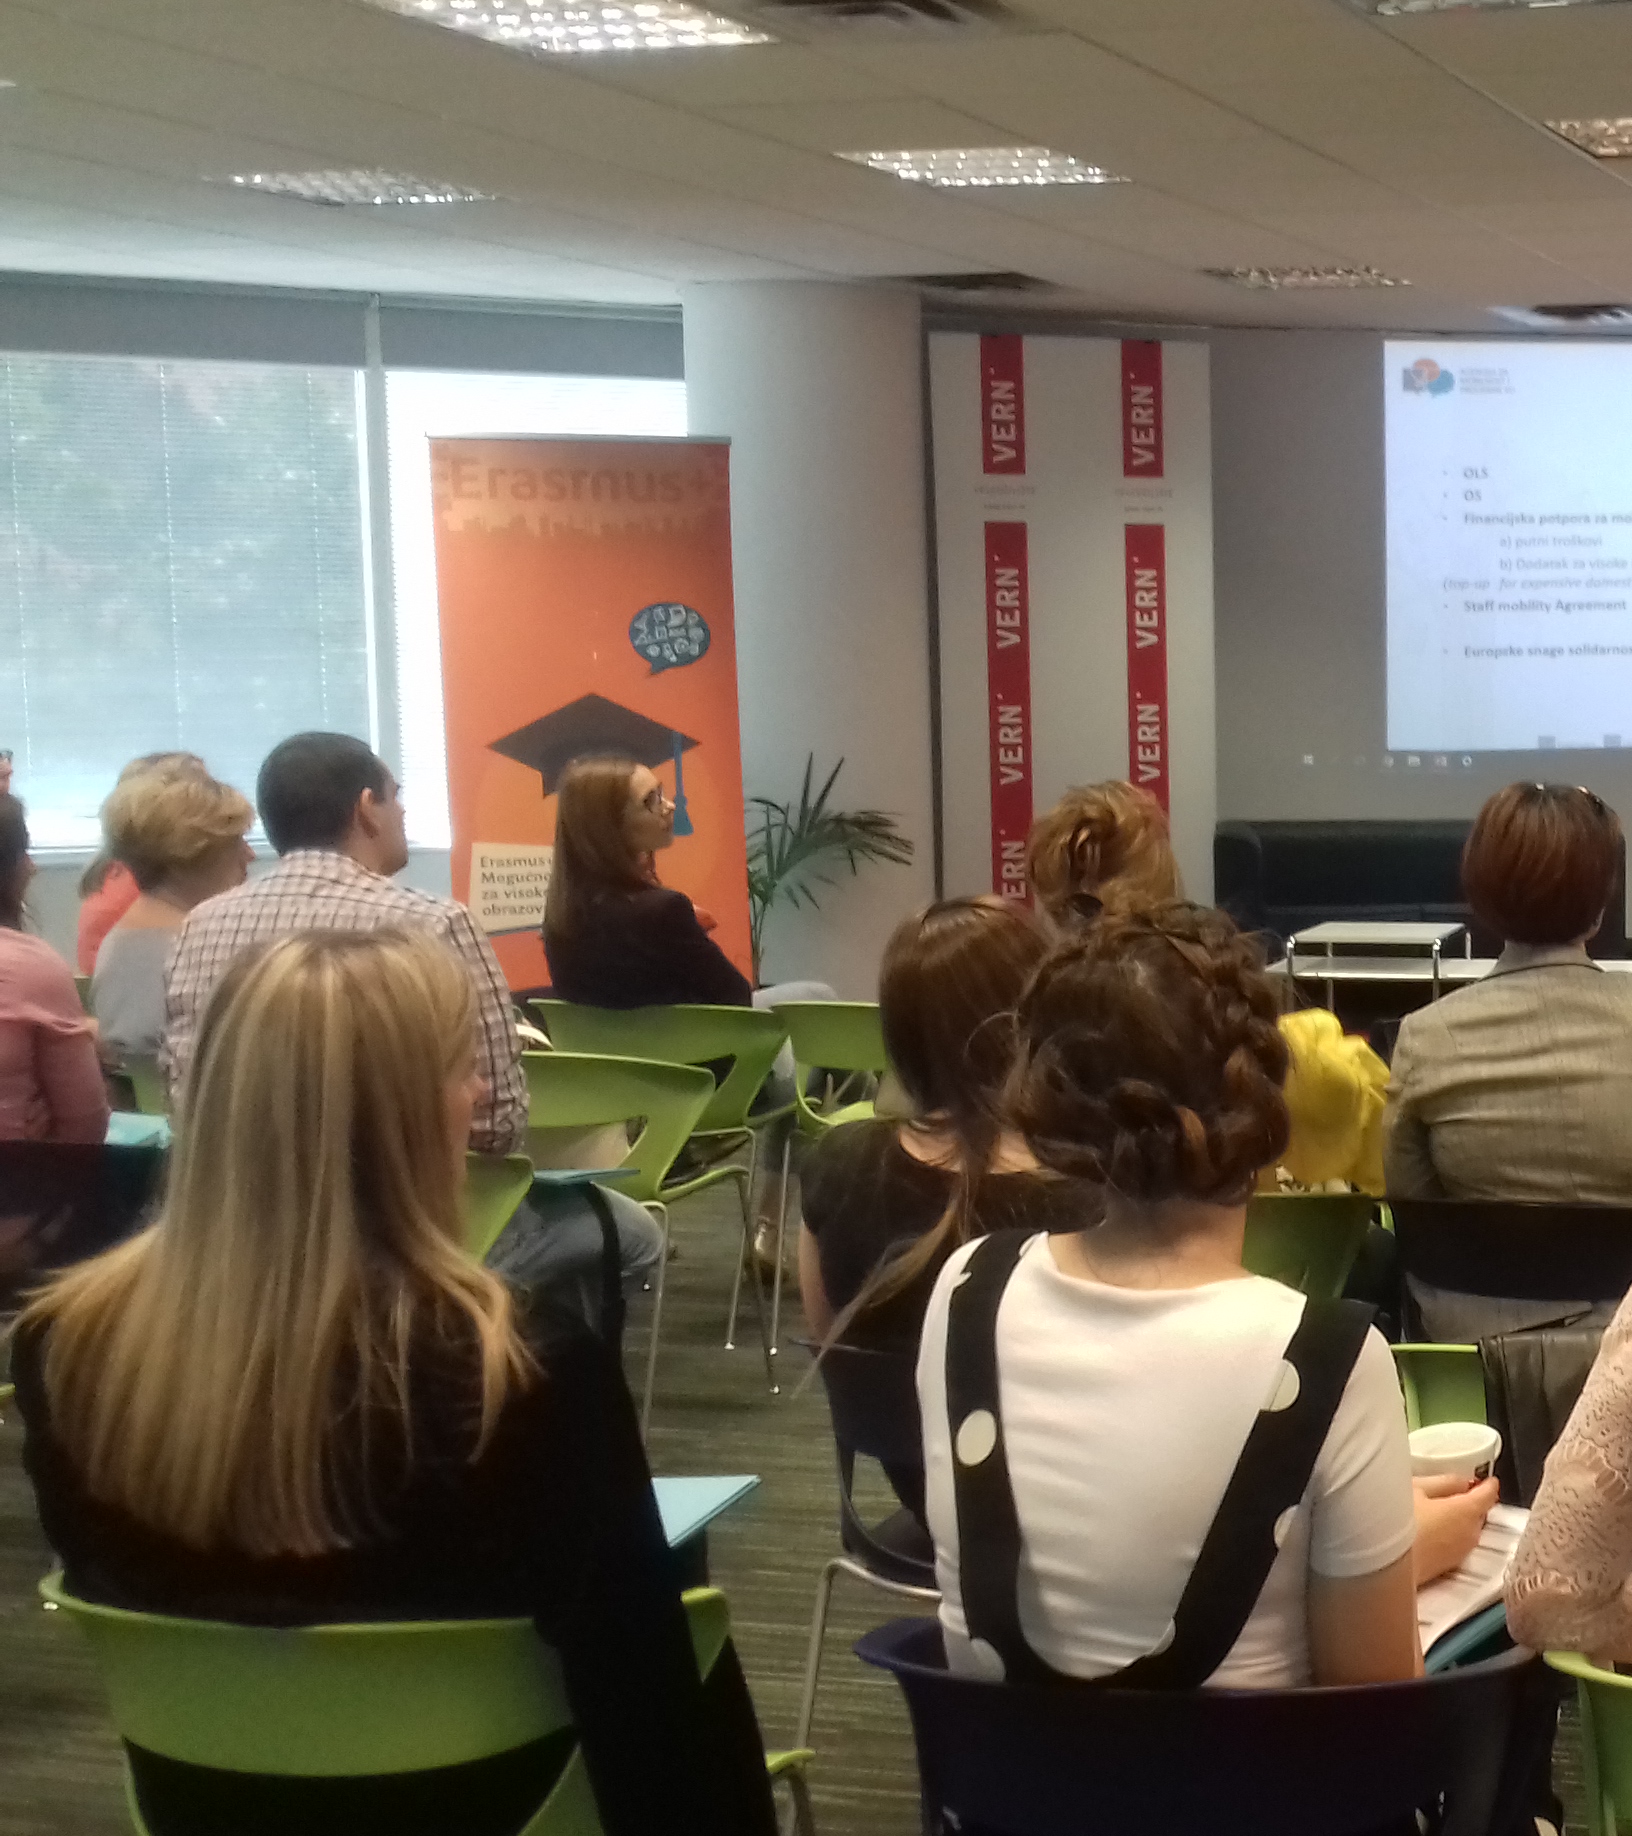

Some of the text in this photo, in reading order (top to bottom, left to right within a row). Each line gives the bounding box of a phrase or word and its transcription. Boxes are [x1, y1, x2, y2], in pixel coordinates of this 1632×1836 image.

[1463, 467, 1489, 479] OLS
[1464, 512, 1536, 526] Financijska
[1539, 513, 1590, 526] potpora
[1594, 515, 1608, 524] za
[1515, 536, 1549, 549] putni
[1500, 557, 1512, 571] b)
[1516, 557, 1568, 569] Dodatak
[1464, 599, 1627, 613] Staff mobility Agreement
[1464, 645, 1524, 659] Europske
[1527, 646, 1565, 658] snage
[1000, 829, 1027, 900] ERN'
[481, 871, 552, 886] Mogućno
[482, 887, 547, 900] za visok
[482, 904, 544, 916] obrazov
